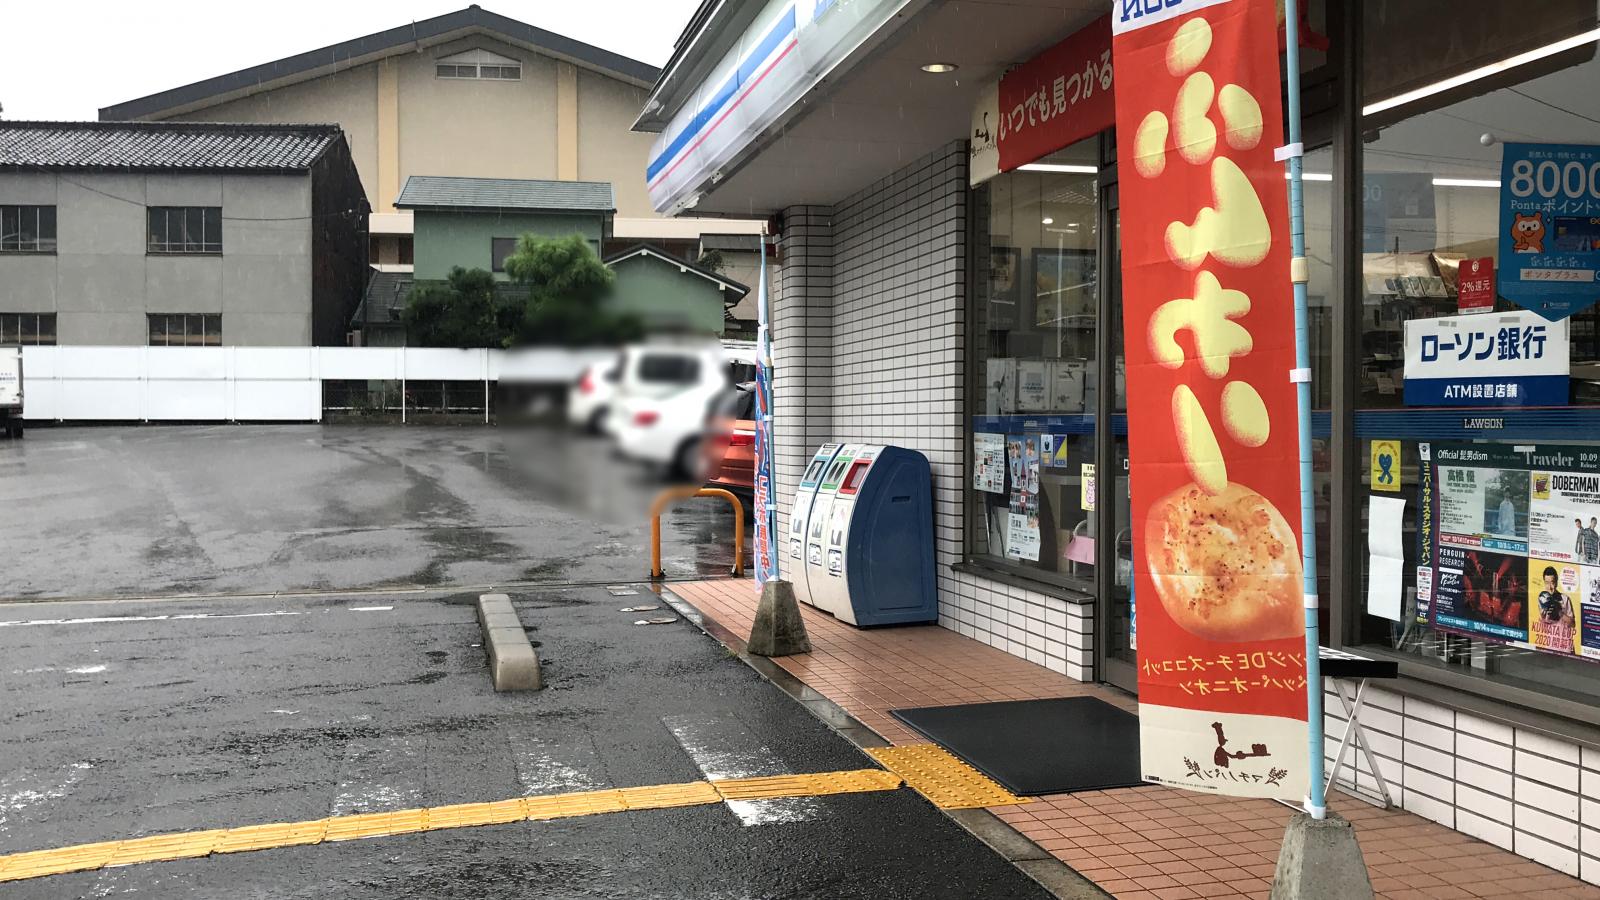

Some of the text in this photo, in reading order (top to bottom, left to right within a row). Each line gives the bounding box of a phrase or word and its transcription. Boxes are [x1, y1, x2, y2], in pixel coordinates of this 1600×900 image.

[1000, 49, 1113, 141] いつでも見つかる
[1461, 279, 1490, 293] 2%還元
[1421, 326, 1546, 362] ローソン銀行
[1444, 383, 1518, 399] ATM設置店舗
[1464, 418, 1504, 429] LAWSON
[1437, 450, 1459, 460] Official
[1523, 450, 1574, 468] Traveler
[1580, 452, 1598, 462] 10.09
[1552, 474, 1599, 493] DOBERMAN
[1439, 548, 1465, 559] PENGUIN
[1439, 557, 1465, 568] RESEARCH
[1531, 621, 1577, 639] KUWATA CUP
[1535, 634, 1551, 647] 2020
